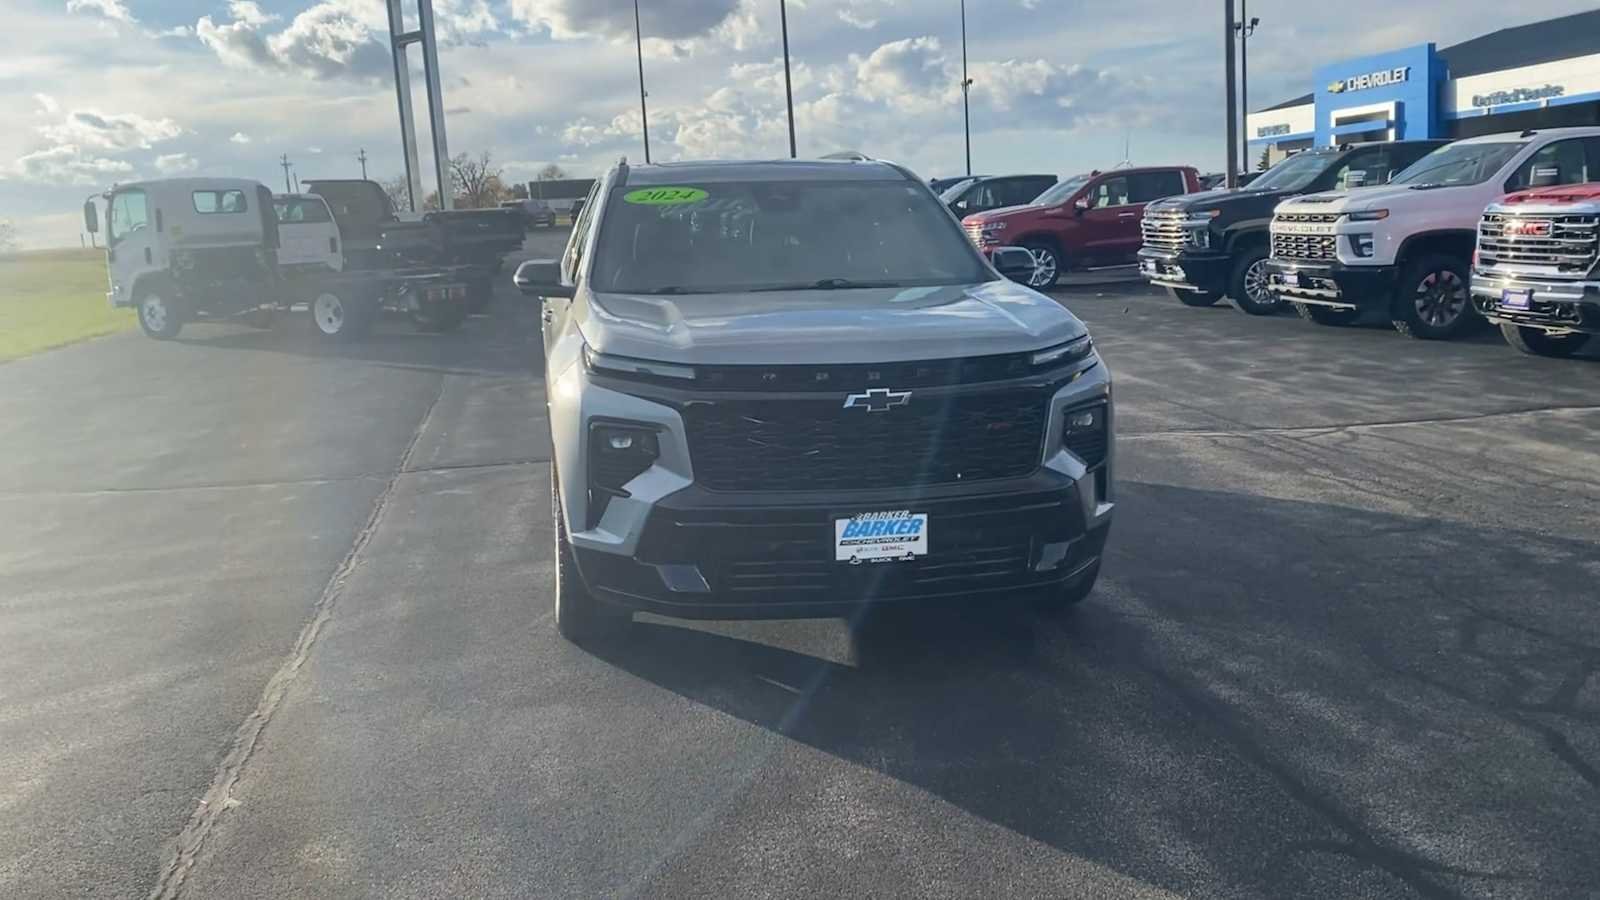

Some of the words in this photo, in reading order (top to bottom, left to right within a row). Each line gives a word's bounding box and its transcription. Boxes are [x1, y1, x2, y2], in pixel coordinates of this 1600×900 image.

[1346, 66, 1409, 91] CHEVROLET
[636, 190, 695, 201] 2024
[1504, 222, 1549, 236] GMC
[863, 509, 910, 520] BARKER
[842, 518, 924, 538] BARKER
